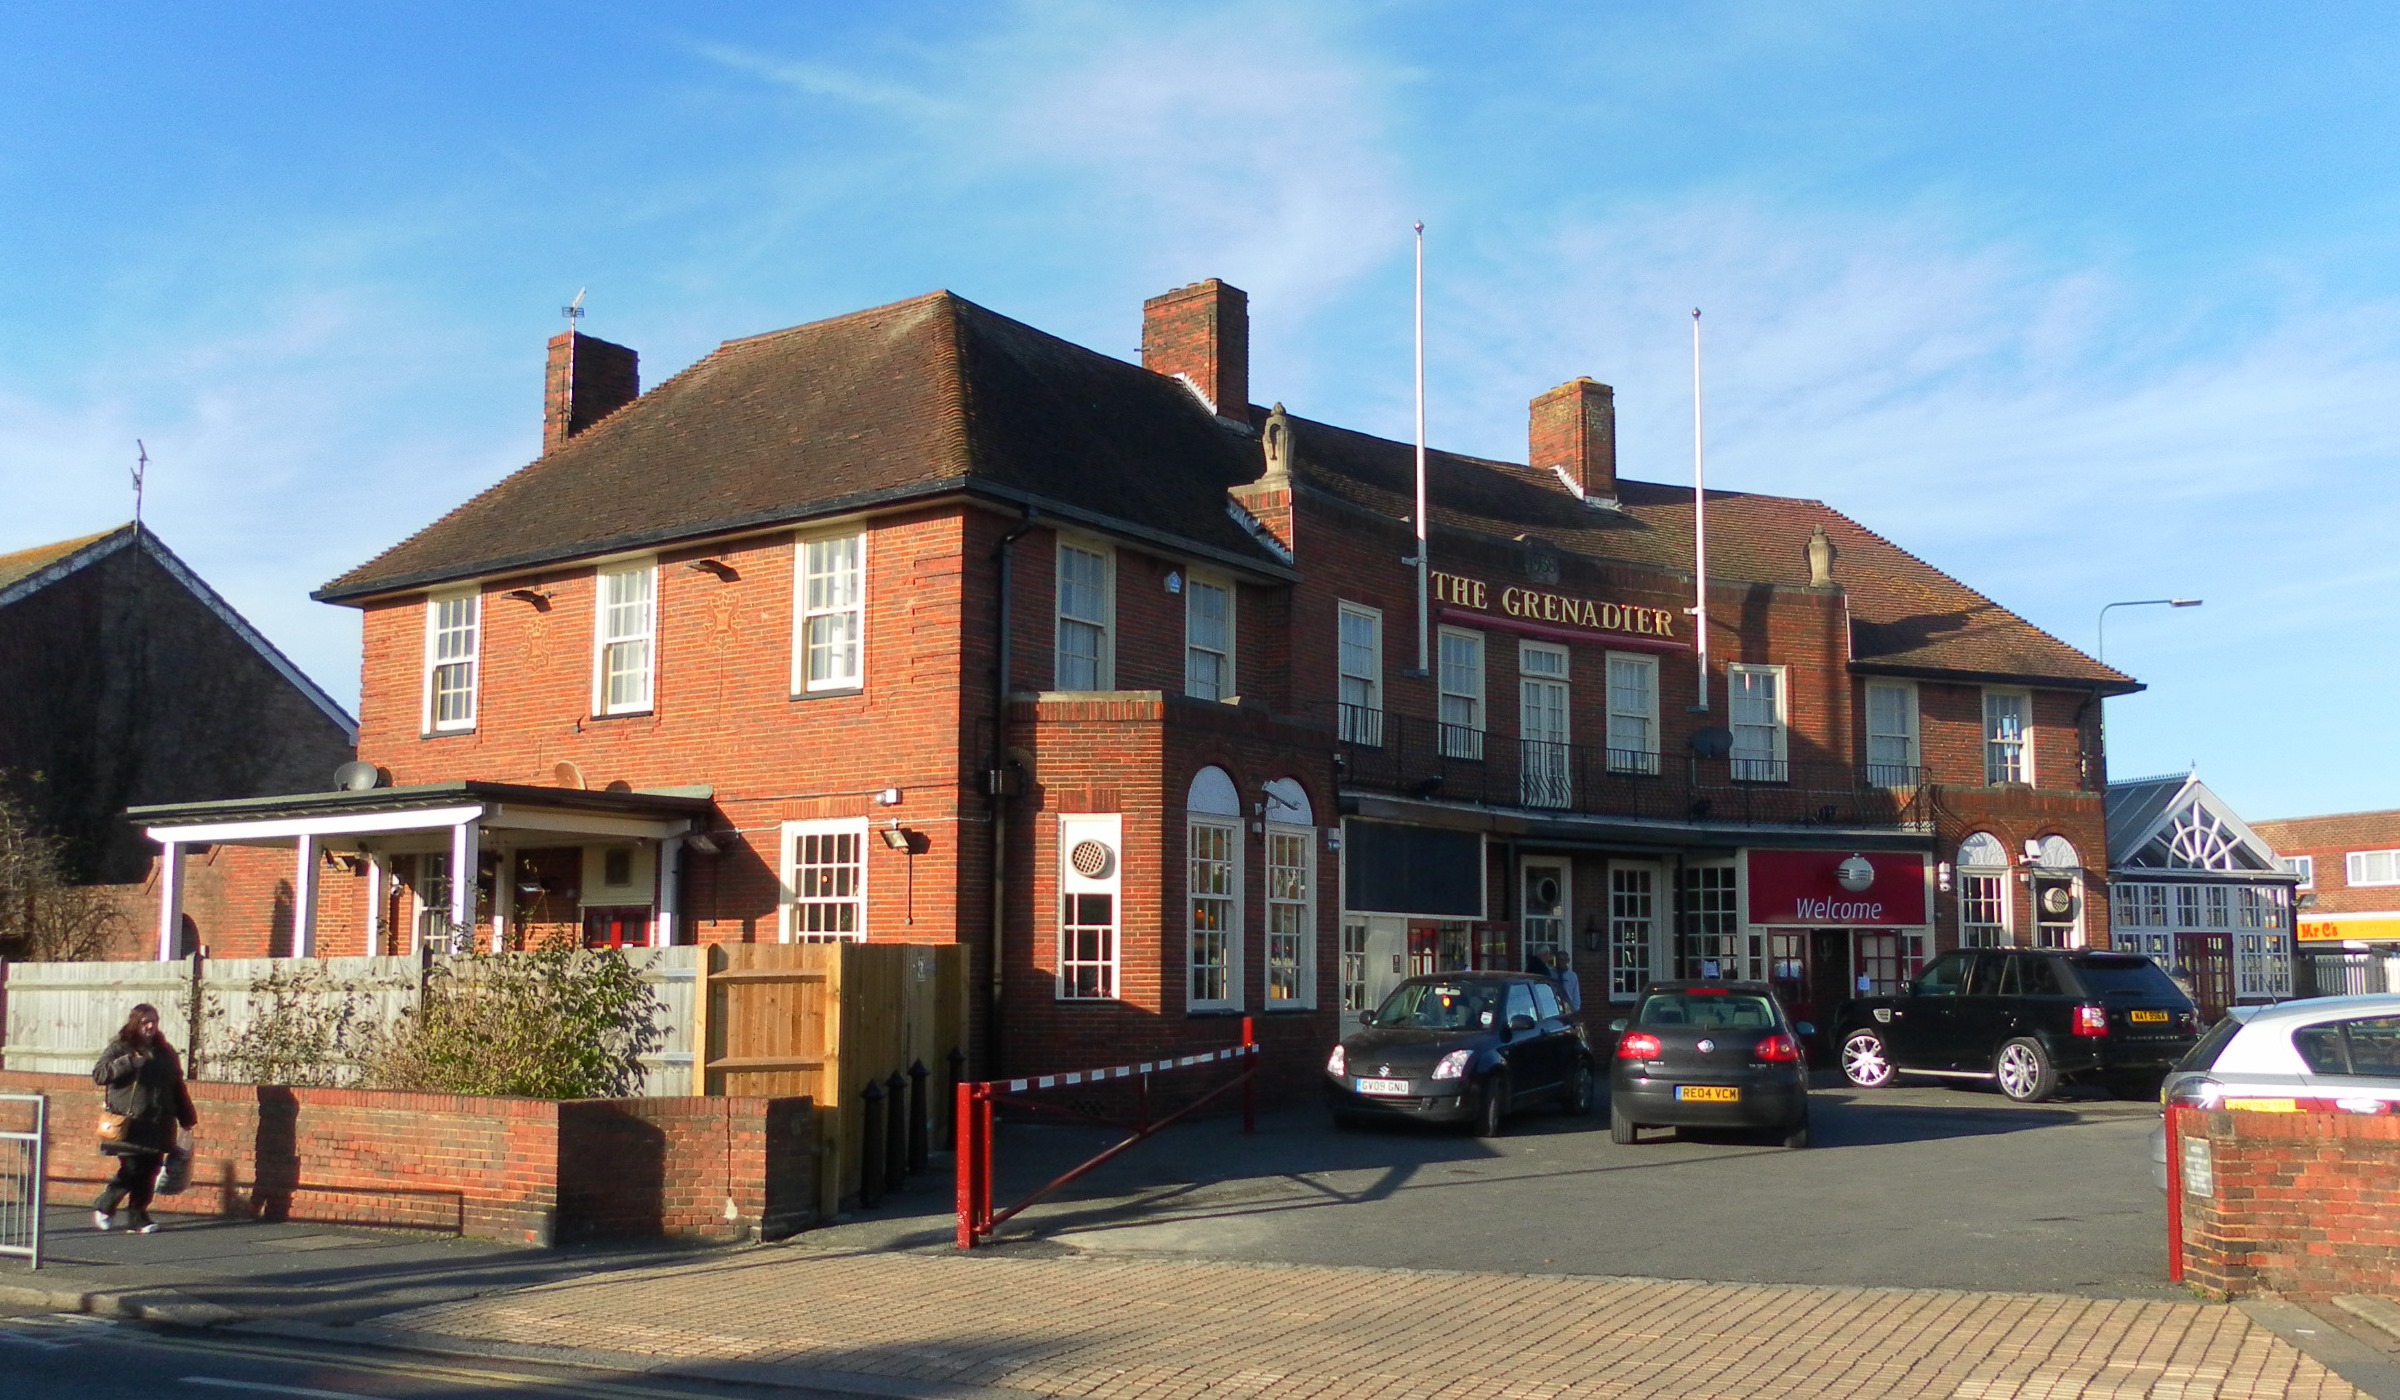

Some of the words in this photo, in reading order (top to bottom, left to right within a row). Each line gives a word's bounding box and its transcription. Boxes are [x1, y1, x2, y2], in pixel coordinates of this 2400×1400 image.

[1430, 570, 1488, 610] THE
[1502, 586, 1675, 637] GRENADIER
[1796, 895, 1882, 920] Welcome
[2301, 923, 2319, 938] Mr
[2322, 921, 2338, 938] C's
[1361, 1080, 1386, 1092] GV09
[1388, 1080, 1407, 1093] GNU
[1683, 1088, 1712, 1098] RE04
[1715, 1088, 1736, 1098] VCM
